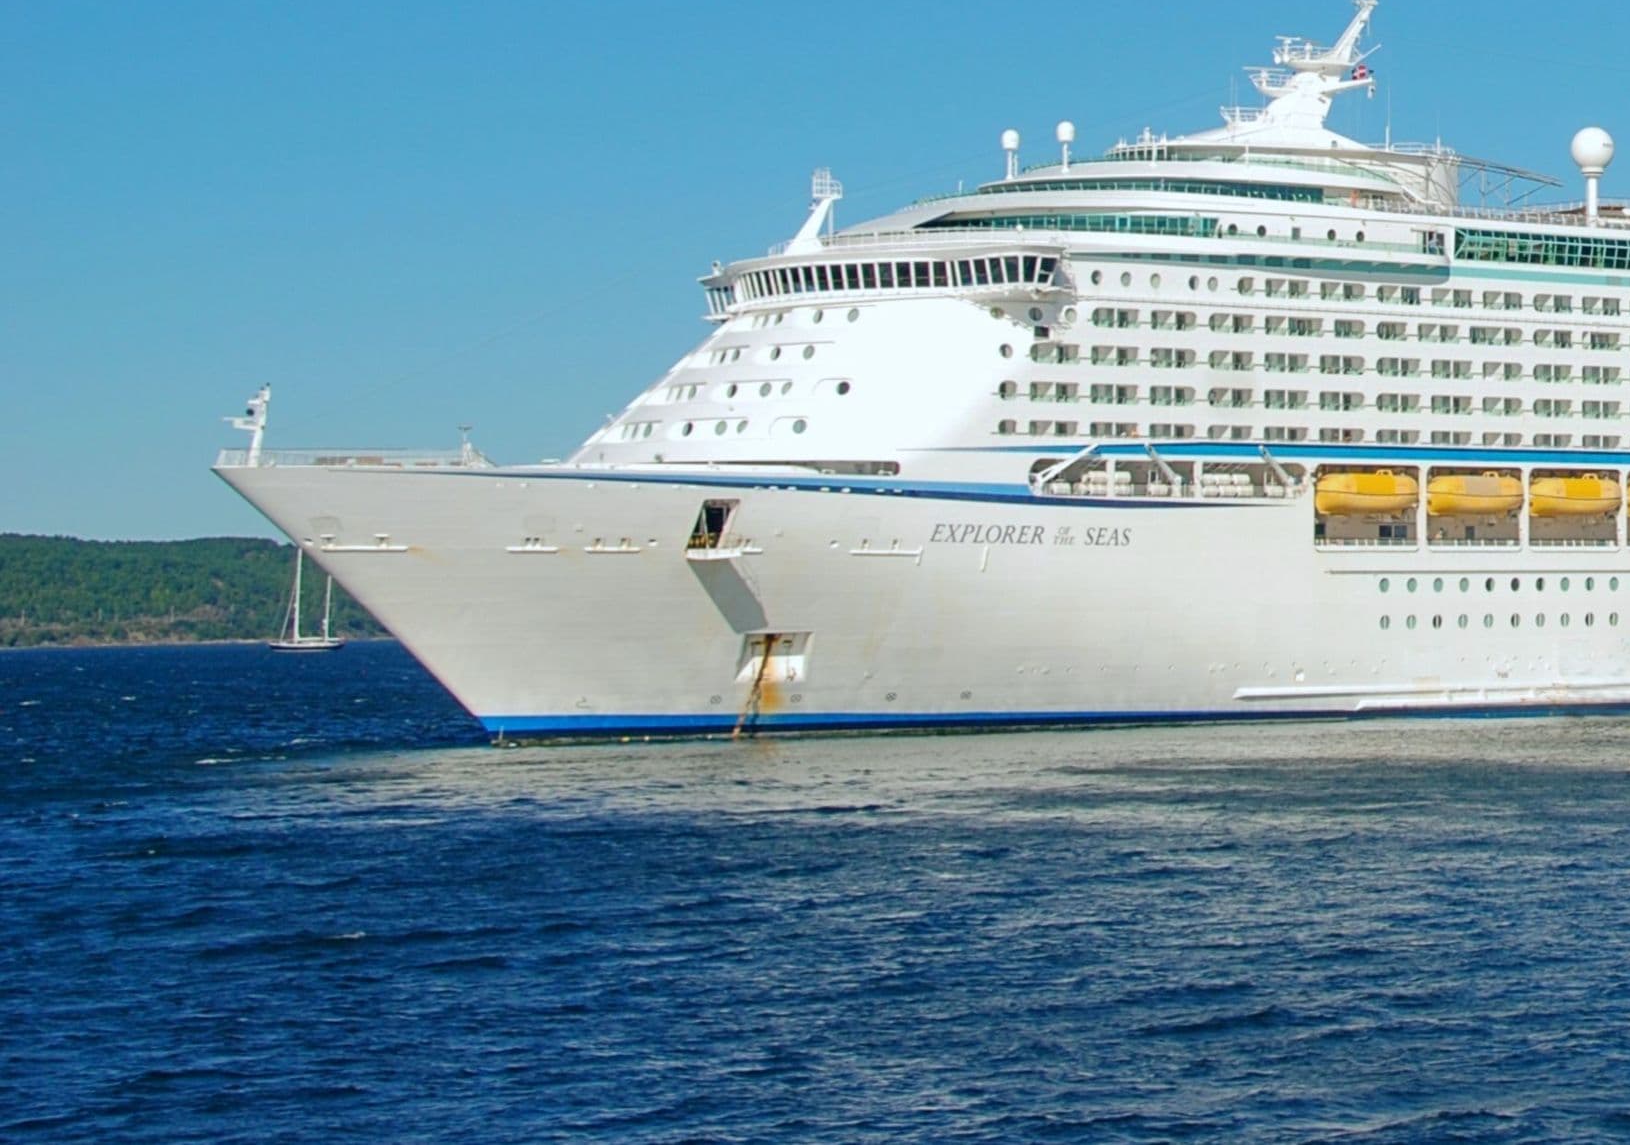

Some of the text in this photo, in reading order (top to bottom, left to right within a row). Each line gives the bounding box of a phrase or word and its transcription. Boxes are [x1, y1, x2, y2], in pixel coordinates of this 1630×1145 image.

[930, 523, 1132, 546] EXPLORER OF THE SEAS
